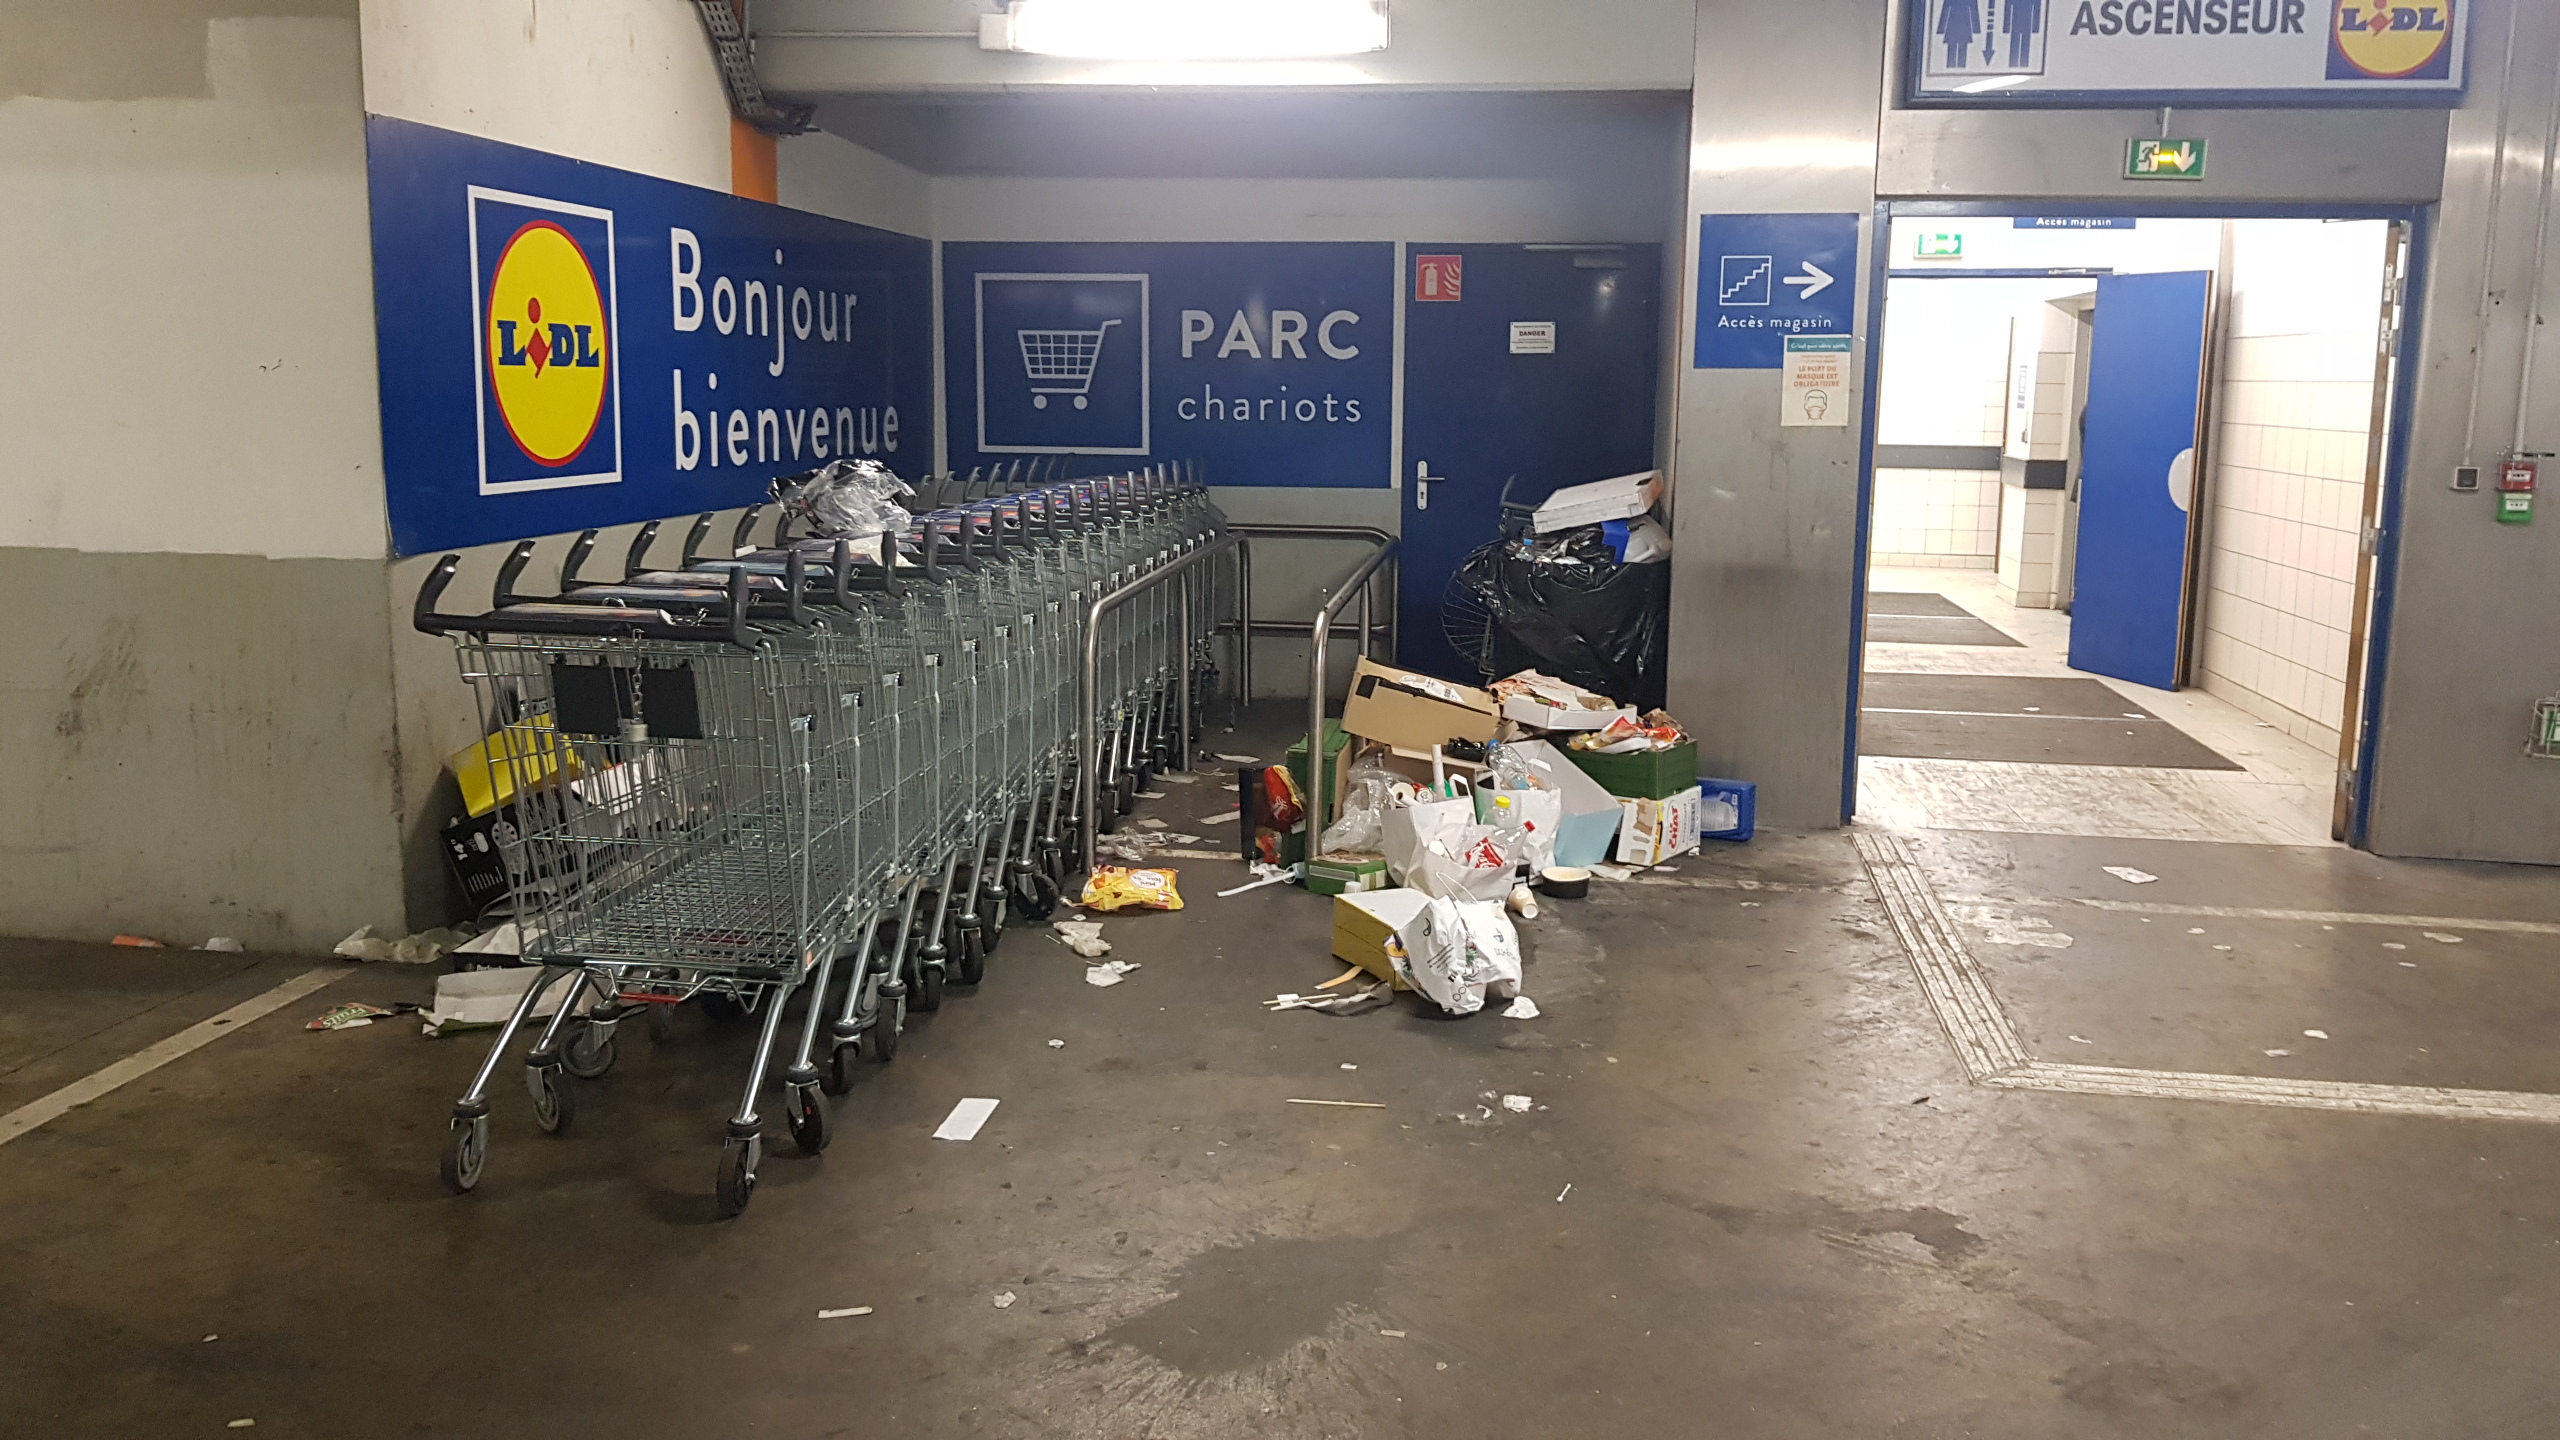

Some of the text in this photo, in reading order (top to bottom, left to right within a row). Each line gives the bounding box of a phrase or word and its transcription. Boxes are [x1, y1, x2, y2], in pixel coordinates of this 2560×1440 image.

[2069, 0, 2305, 36] ASCENSEUR
[2070, 218, 2112, 229] magasin
[670, 226, 858, 377] Bonjour
[1180, 309, 1361, 360] PARC
[1717, 314, 1832, 332] Accès magasin
[672, 368, 900, 471] bienvenue
[1177, 385, 1363, 424] chariots
